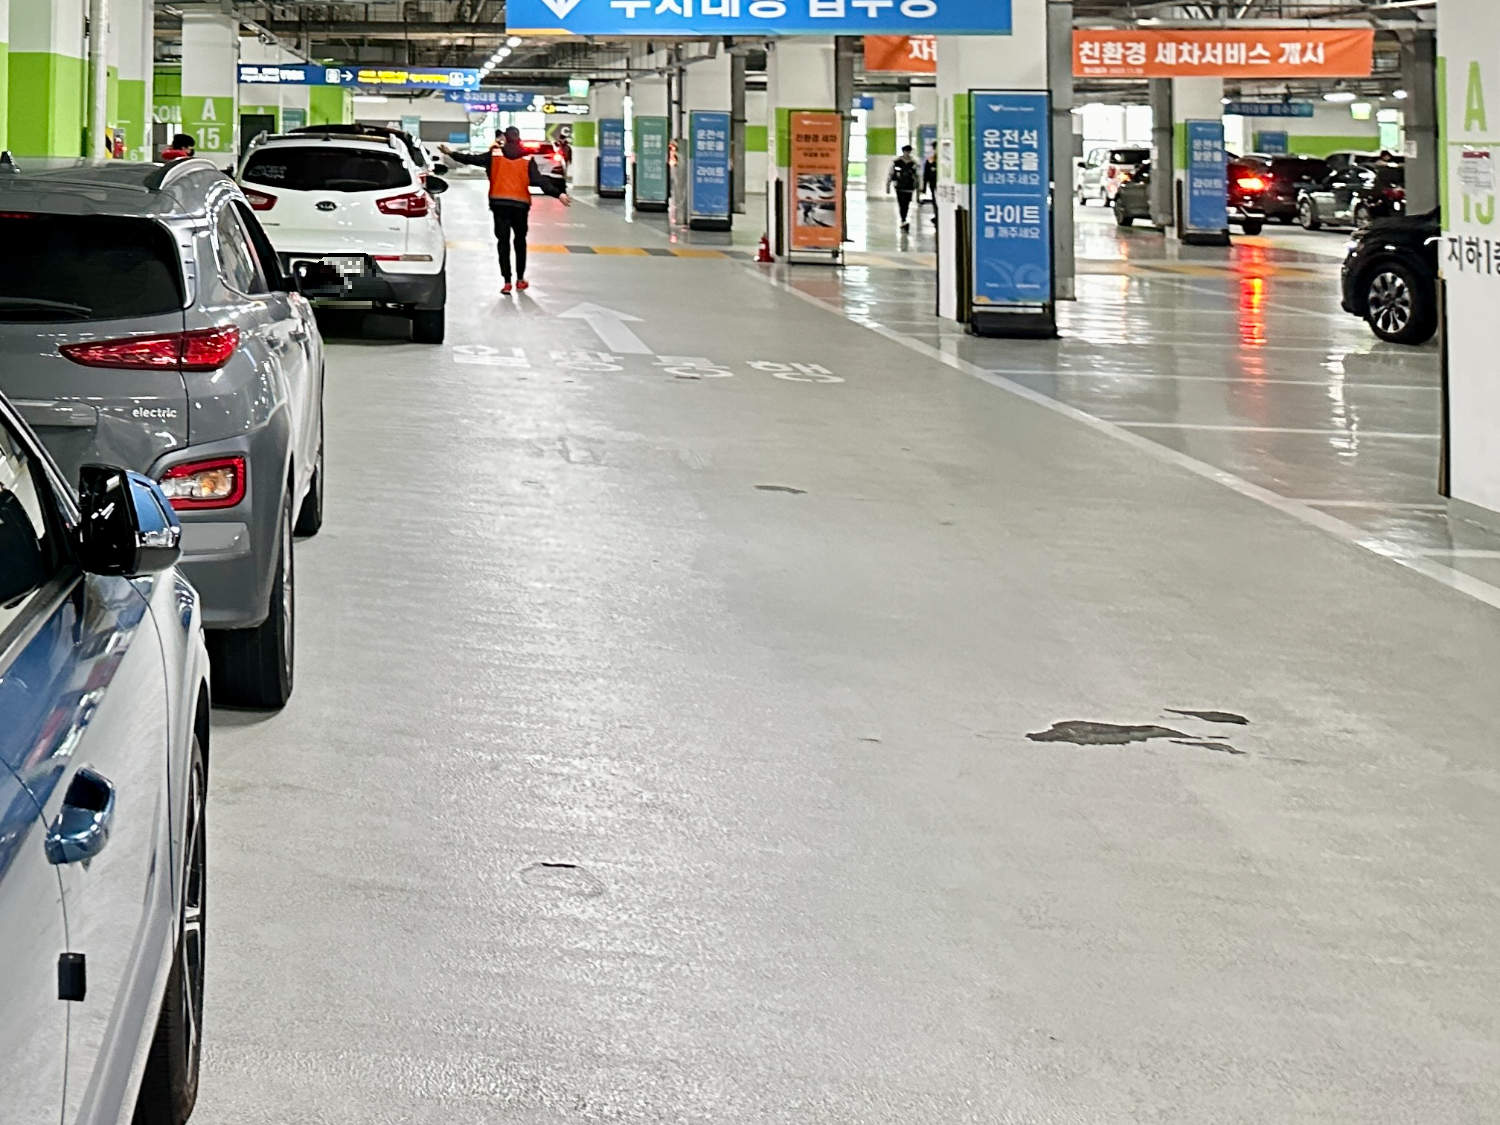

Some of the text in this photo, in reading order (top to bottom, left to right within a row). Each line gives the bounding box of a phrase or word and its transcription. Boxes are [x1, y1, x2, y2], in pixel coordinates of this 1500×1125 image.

[1078, 41, 1325, 65] 친환경 세차서비스 개시
[1464, 61, 1487, 131] A
[201, 98, 217, 121] A
[196, 127, 220, 150] 15
[982, 128, 1039, 149] 운전석
[982, 150, 1040, 171] 창문을
[984, 205, 1041, 224] 라이트
[132, 407, 177, 418] electric
